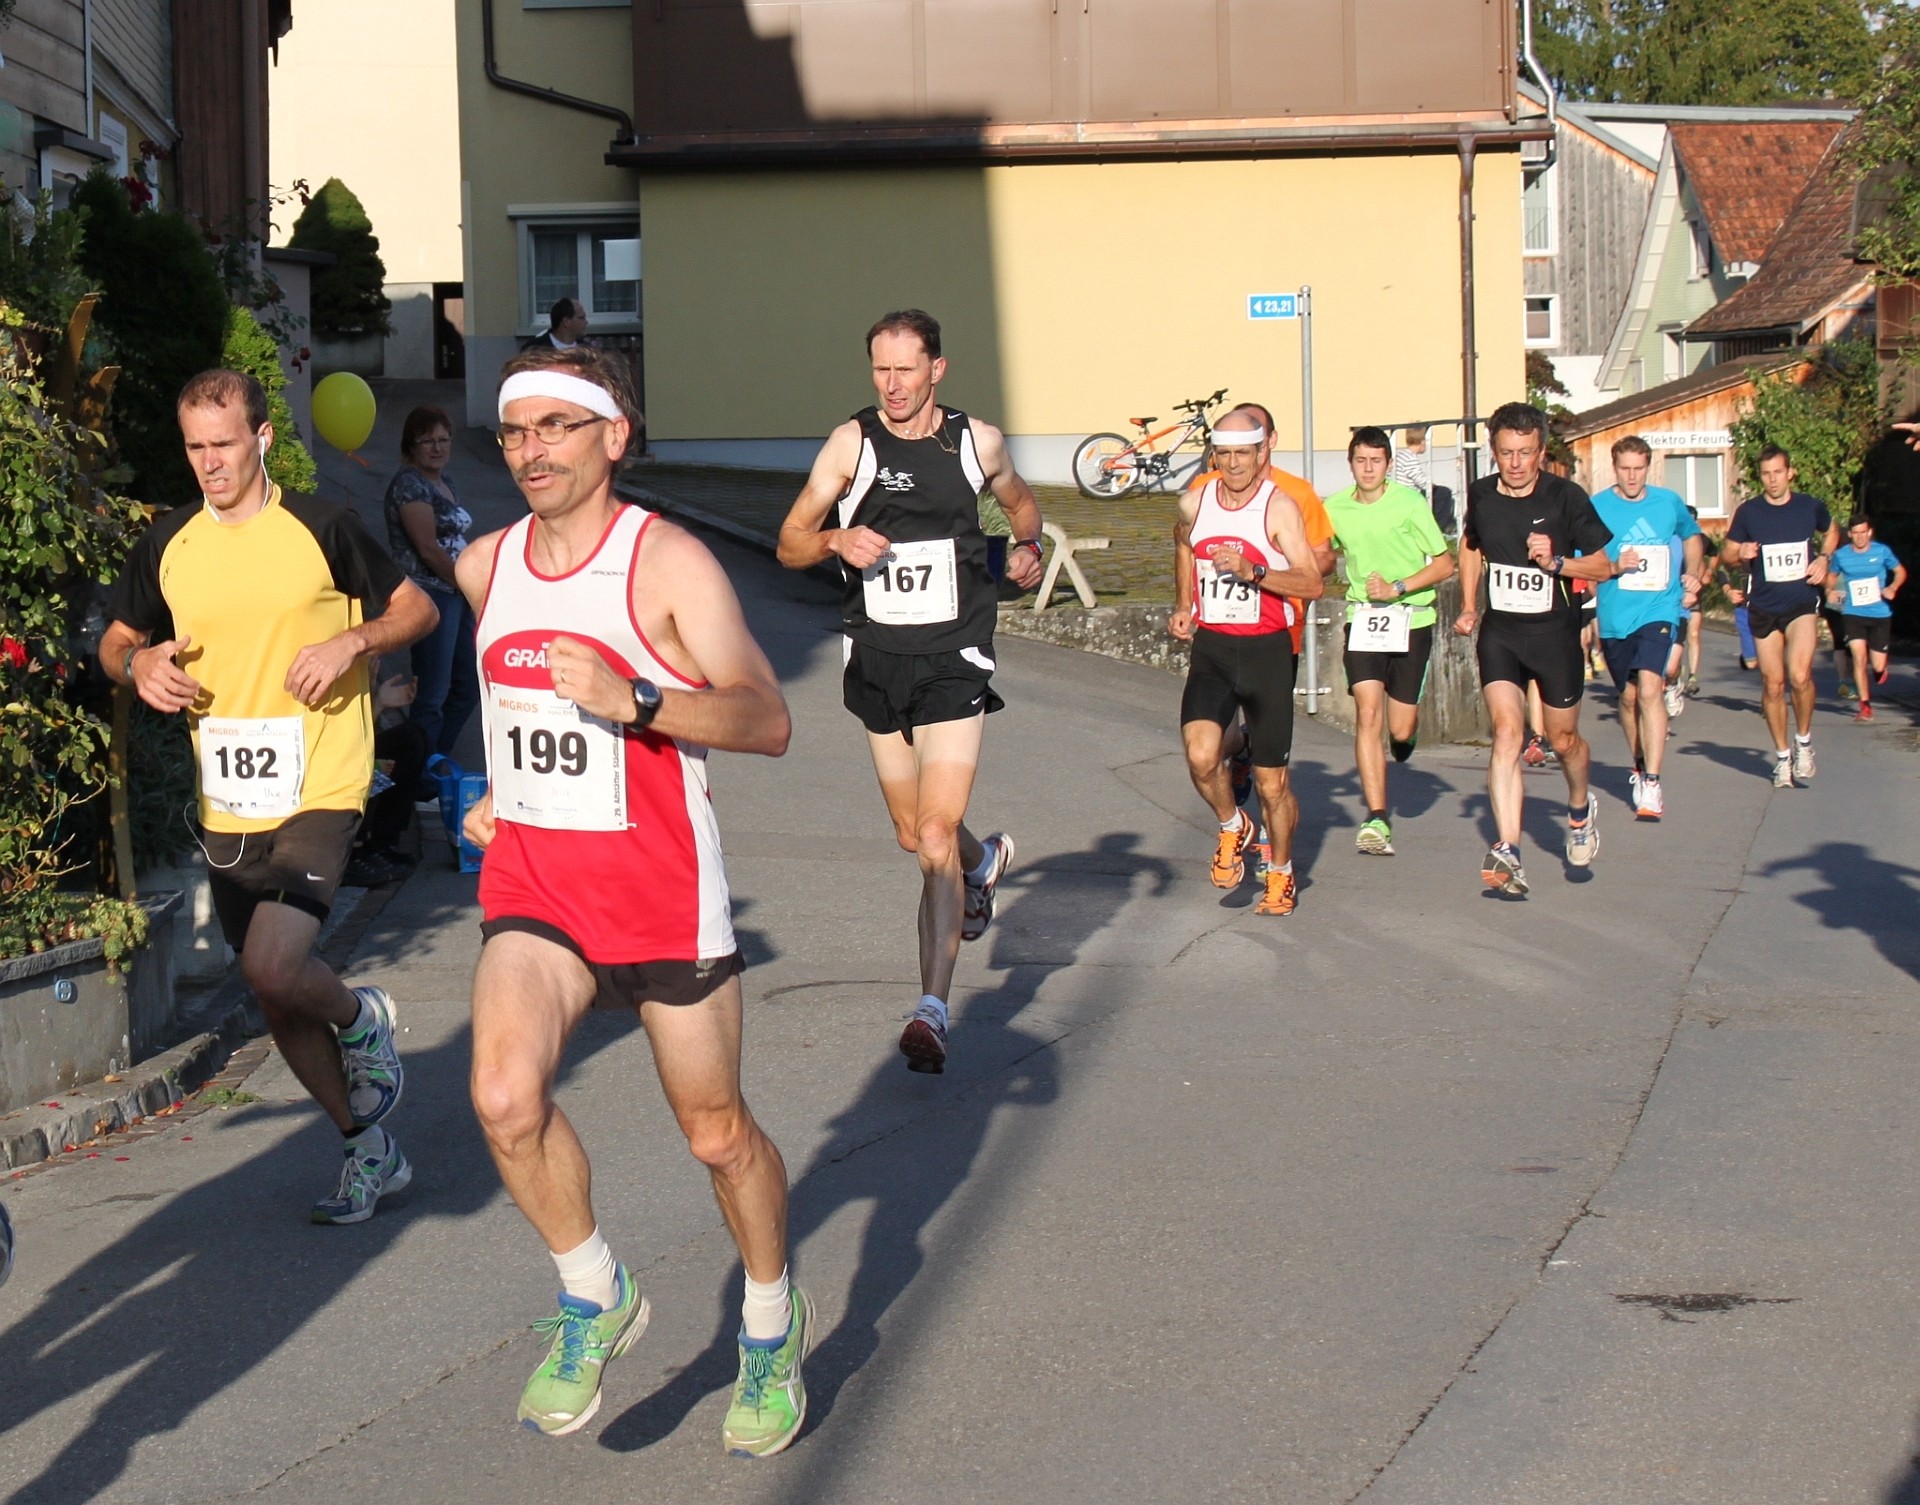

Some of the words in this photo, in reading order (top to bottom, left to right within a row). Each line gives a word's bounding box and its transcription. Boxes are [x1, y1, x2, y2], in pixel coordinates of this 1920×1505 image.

[1264, 300, 1292, 313] 23,21
[1641, 435, 1687, 446] Elektro
[1766, 552, 1803, 567] 1167
[877, 564, 933, 593] 167
[1493, 569, 1544, 592] 1169
[1200, 576, 1250, 602] 1173
[1856, 586, 1869, 596] 27
[1367, 615, 1391, 633] 52
[498, 698, 539, 713] MIGROS
[208, 727, 240, 737] MIGROS
[507, 725, 588, 777] 199
[215, 746, 279, 779] 182
